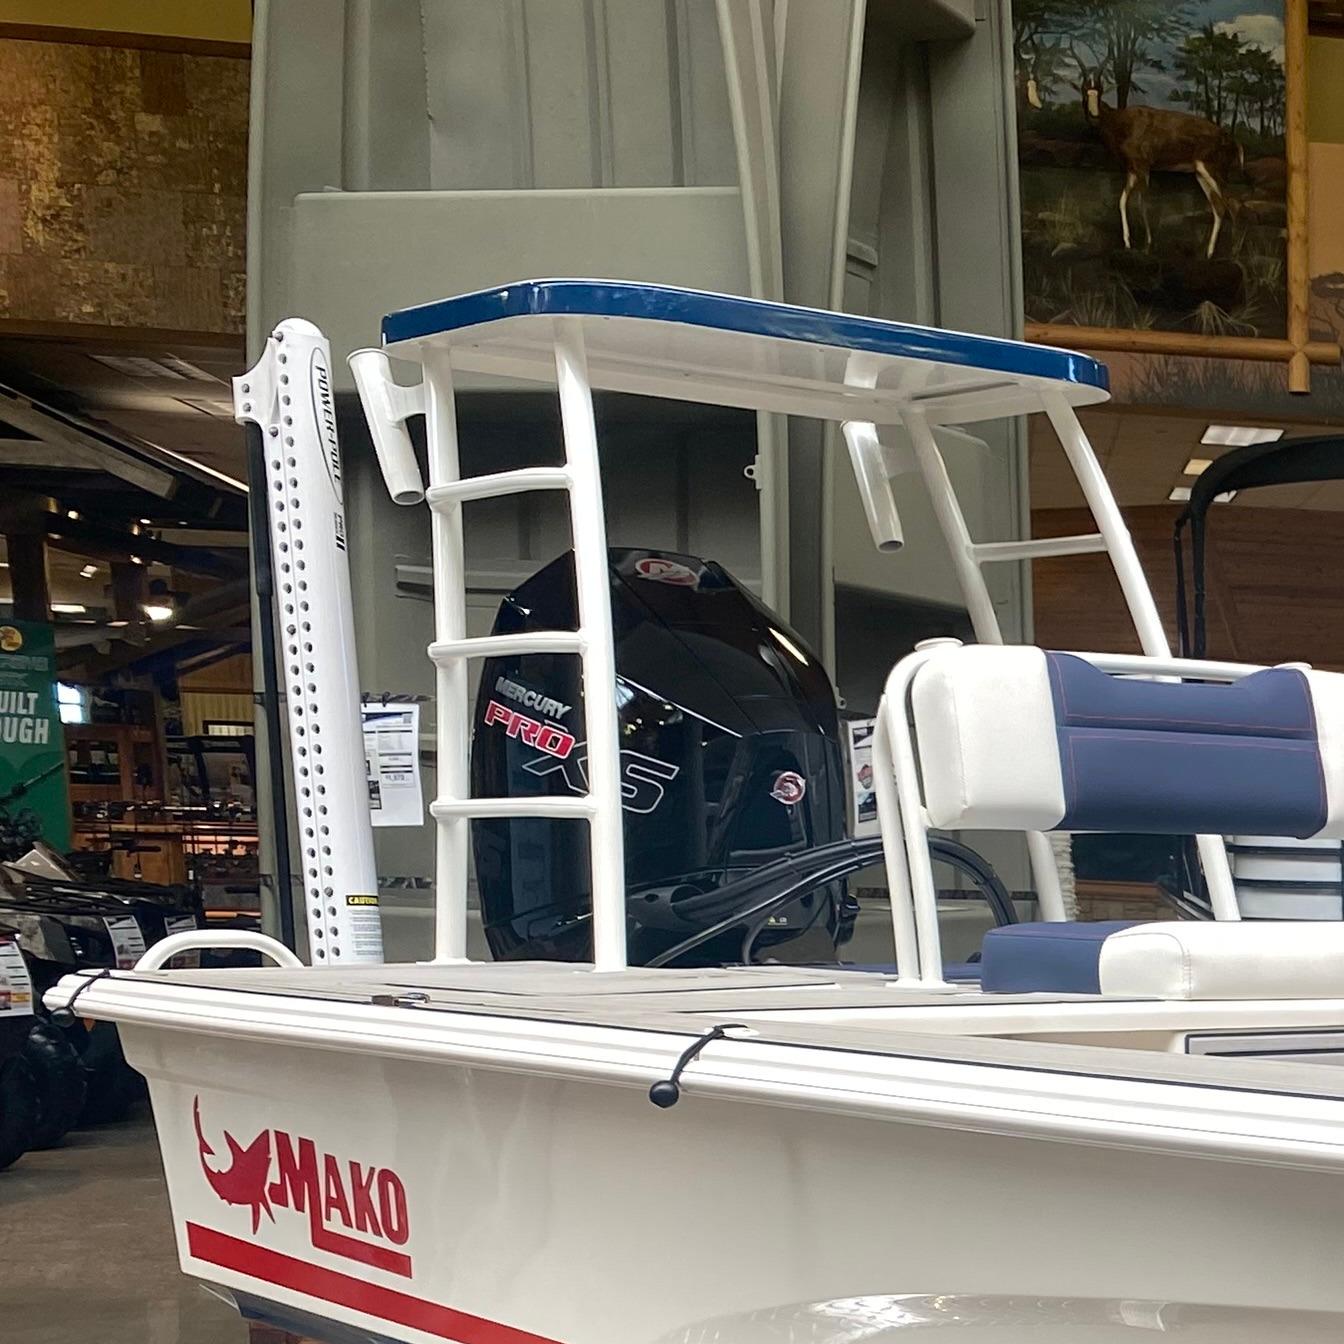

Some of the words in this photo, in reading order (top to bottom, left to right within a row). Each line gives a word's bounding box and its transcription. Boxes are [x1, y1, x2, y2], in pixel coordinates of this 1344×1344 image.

[494, 676, 573, 720] MERCURY
[0, 717, 49, 744] UGH
[484, 700, 575, 760] PRO
[267, 1129, 412, 1280] MAKO
